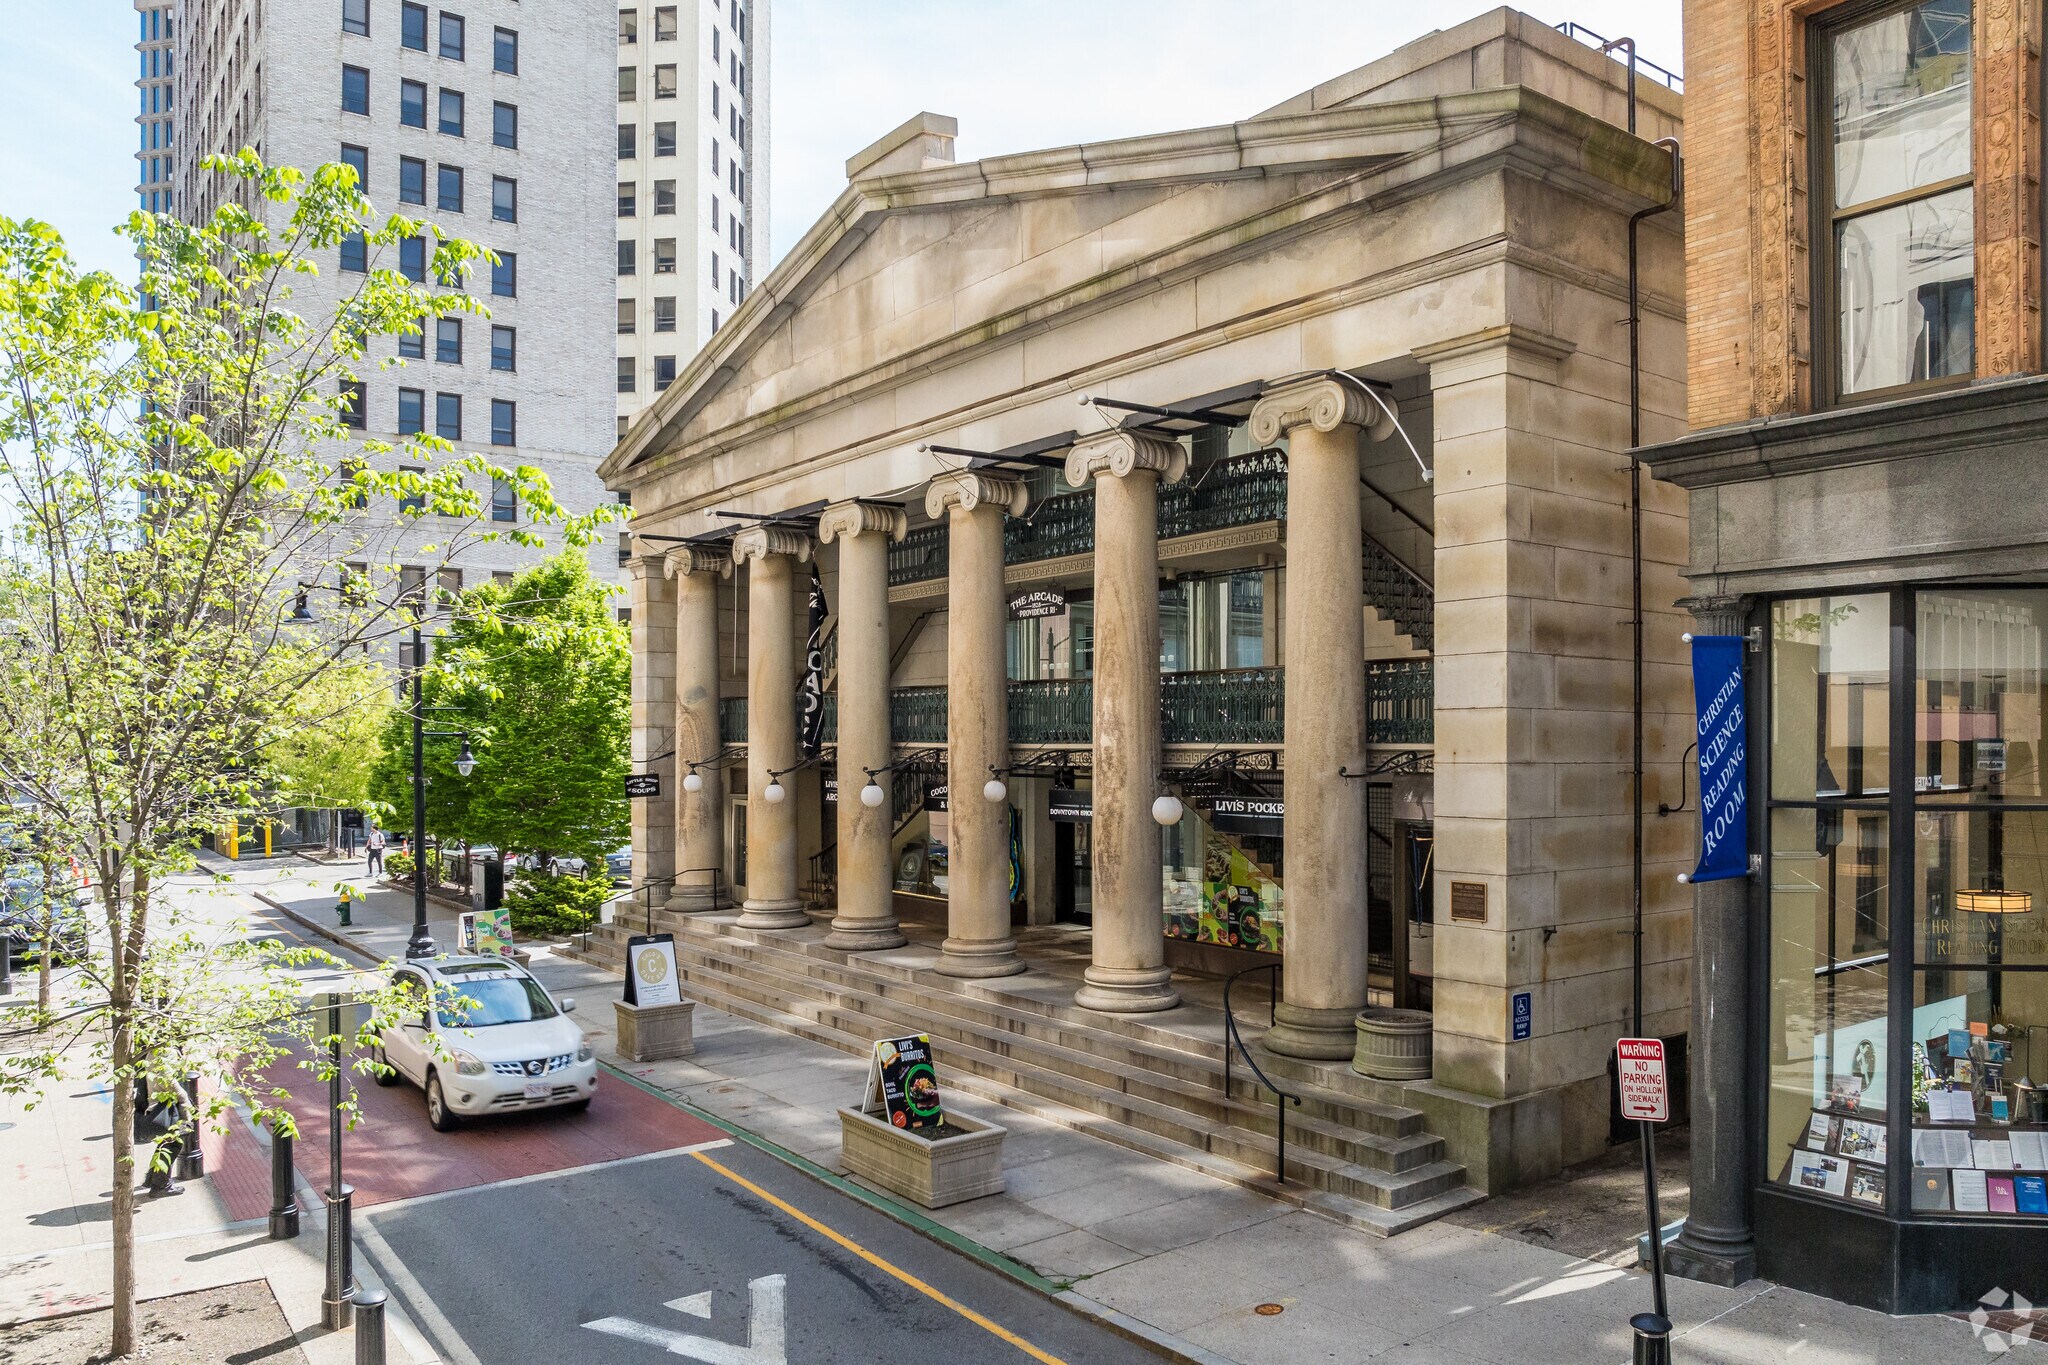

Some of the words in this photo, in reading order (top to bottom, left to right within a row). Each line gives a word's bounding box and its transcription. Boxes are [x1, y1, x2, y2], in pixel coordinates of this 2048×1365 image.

[1010, 595, 1027, 610] THE
[1028, 592, 1064, 606] ARCADE
[1019, 608, 1048, 618] PROVIDENCE
[1698, 665, 1742, 736] CHRISTIAN
[1700, 703, 1744, 776] SCIENCE
[626, 778, 644, 786] LITTLE
[1702, 742, 1745, 815] READING
[632, 786, 656, 794] SOUPS
[1050, 808, 1079, 816] DOWNTOWN
[1704, 780, 1746, 857] ROOM
[1922, 916, 1997, 934] CHRISTIAN
[1937, 939, 1998, 955] READING
[1514, 1015, 1530, 1023] ACCESS
[899, 1041, 913, 1051] LIVI'S
[1620, 1044, 1660, 1058] WARNING
[901, 1050, 924, 1061] BURRITOS
[1635, 1061, 1648, 1072] NO
[1624, 1073, 1662, 1085] PARKING
[1624, 1084, 1634, 1092] ON
[1636, 1086, 1662, 1094] HOLLOW
[1628, 1094, 1660, 1104] SIDEWALK
